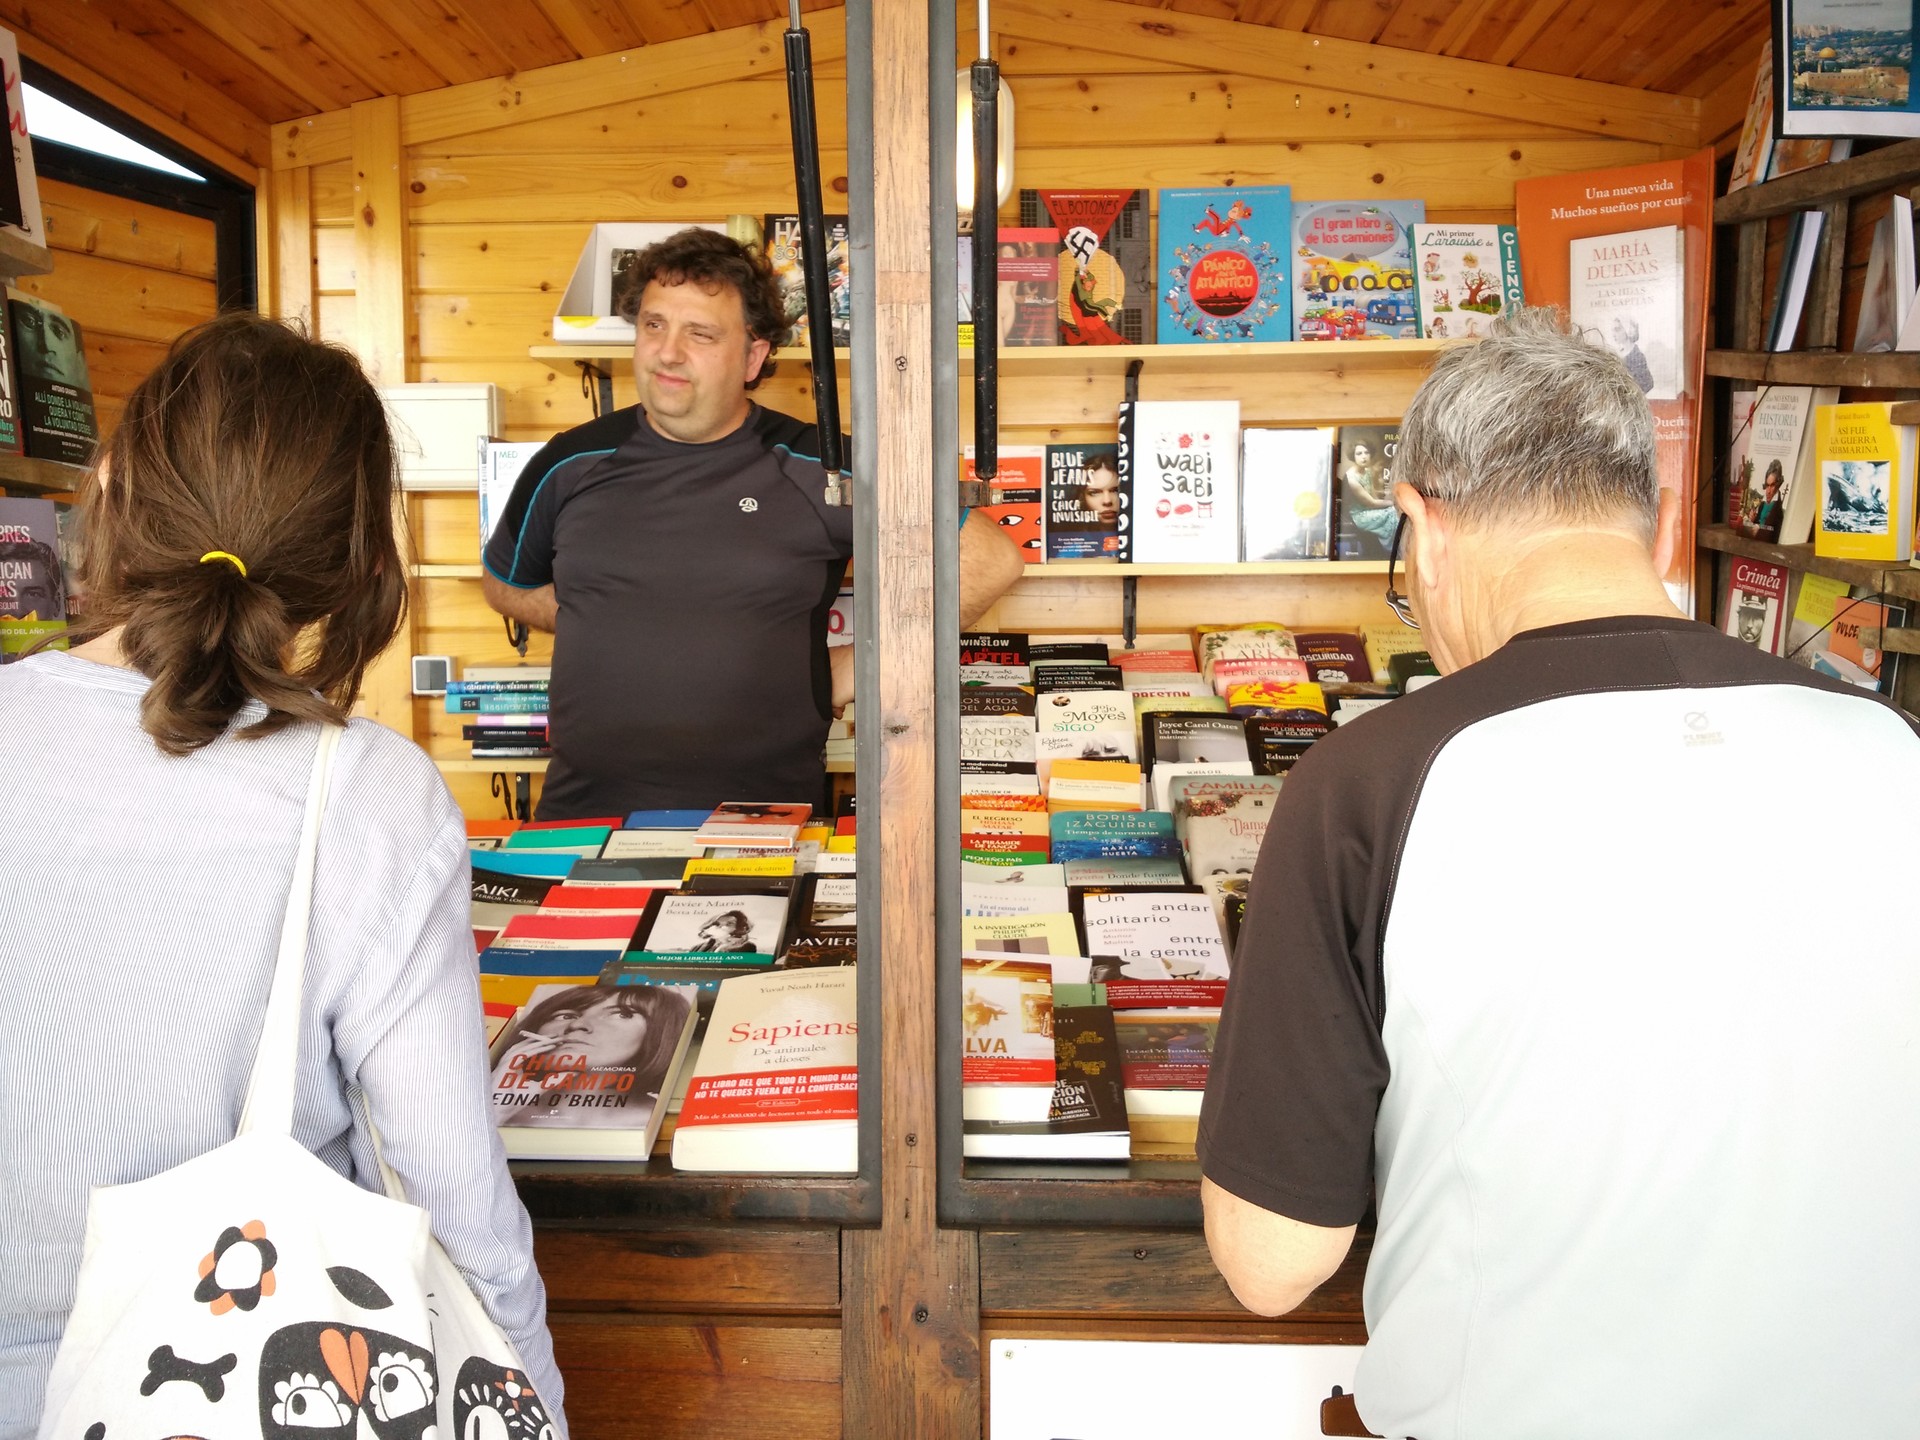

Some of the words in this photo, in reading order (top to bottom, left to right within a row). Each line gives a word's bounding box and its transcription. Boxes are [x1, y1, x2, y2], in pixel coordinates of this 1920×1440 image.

[1585, 187, 1610, 200] Una
[1612, 184, 1646, 198] nueva
[1649, 179, 1674, 191] vida
[1068, 200, 1119, 215] BOTONES
[1551, 206, 1598, 219] Muchos
[1599, 202, 1639, 214] sueños
[1641, 199, 1662, 213] por
[1314, 218, 1325, 229] El
[1327, 218, 1353, 231] gran
[1355, 217, 1381, 229] libro
[1305, 232, 1320, 244] de
[1322, 231, 1339, 243] los
[1341, 231, 1395, 243] camiones
[1421, 232, 1484, 247] Larousse
[1449, 230, 1475, 238] primer
[1593, 239, 1652, 262] MARÍA
[1587, 259, 1660, 281] DUEÑAS
[1850, 426, 1867, 435] FUE
[1840, 436, 1877, 444] GUERRA
[1829, 446, 1879, 454] SUBMARINA
[1052, 452, 1084, 468] BLUE
[1051, 469, 1094, 485] JEANS
[1053, 490, 1065, 499] LA
[1052, 500, 1081, 511] CHICA
[1053, 511, 1100, 523] INVISIBLE
[1736, 564, 1781, 590] Crimea
[960, 639, 1010, 647] WINSLOW
[1299, 653, 1354, 661] OSCURIDAD
[1062, 711, 1127, 724] Moyes
[1053, 723, 1096, 732] SIGO
[1158, 721, 1183, 729] Joyce
[1211, 722, 1239, 730] Oates
[1066, 821, 1158, 829] IZAGUIRRE
[822, 883, 851, 892] Jorge
[669, 900, 702, 908] Javier
[705, 900, 746, 908] Marías
[1098, 895, 1126, 903] Un
[1151, 903, 1210, 913] andar
[985, 922, 1046, 930] INVESTIGACIÓN
[1086, 914, 1171, 927] solitario
[790, 938, 857, 947] JAVIER
[1169, 935, 1224, 945] entre
[1123, 948, 1141, 957] la
[1150, 949, 1211, 959] gente
[760, 985, 785, 993] Yuval
[787, 983, 813, 992] Noah
[814, 981, 846, 989] Harari
[727, 1019, 858, 1046] Sapiens
[753, 1048, 772, 1056] De
[774, 1043, 827, 1054] animales
[508, 1053, 588, 1071] CHICA
[774, 1055, 811, 1064] dioses
[498, 1072, 536, 1090] DE
[540, 1073, 636, 1092] CAMPO
[700, 1082, 710, 1090] EL
[712, 1080, 737, 1089] LIBRO
[738, 1078, 753, 1087] DEL
[756, 1077, 773, 1087] QUE
[775, 1076, 796, 1085] TODO
[798, 1075, 808, 1084] EL
[810, 1074, 839, 1083] MUNDO
[694, 1090, 706, 1099] NO
[709, 1089, 719, 1098] TE
[720, 1088, 753, 1098] QUEDES
[754, 1087, 780, 1096] FUERA
[782, 1086, 793, 1094] DE
[795, 1085, 806, 1094] LA
[493, 1092, 539, 1107] EDNA
[547, 1093, 629, 1108] O'BRIEN
